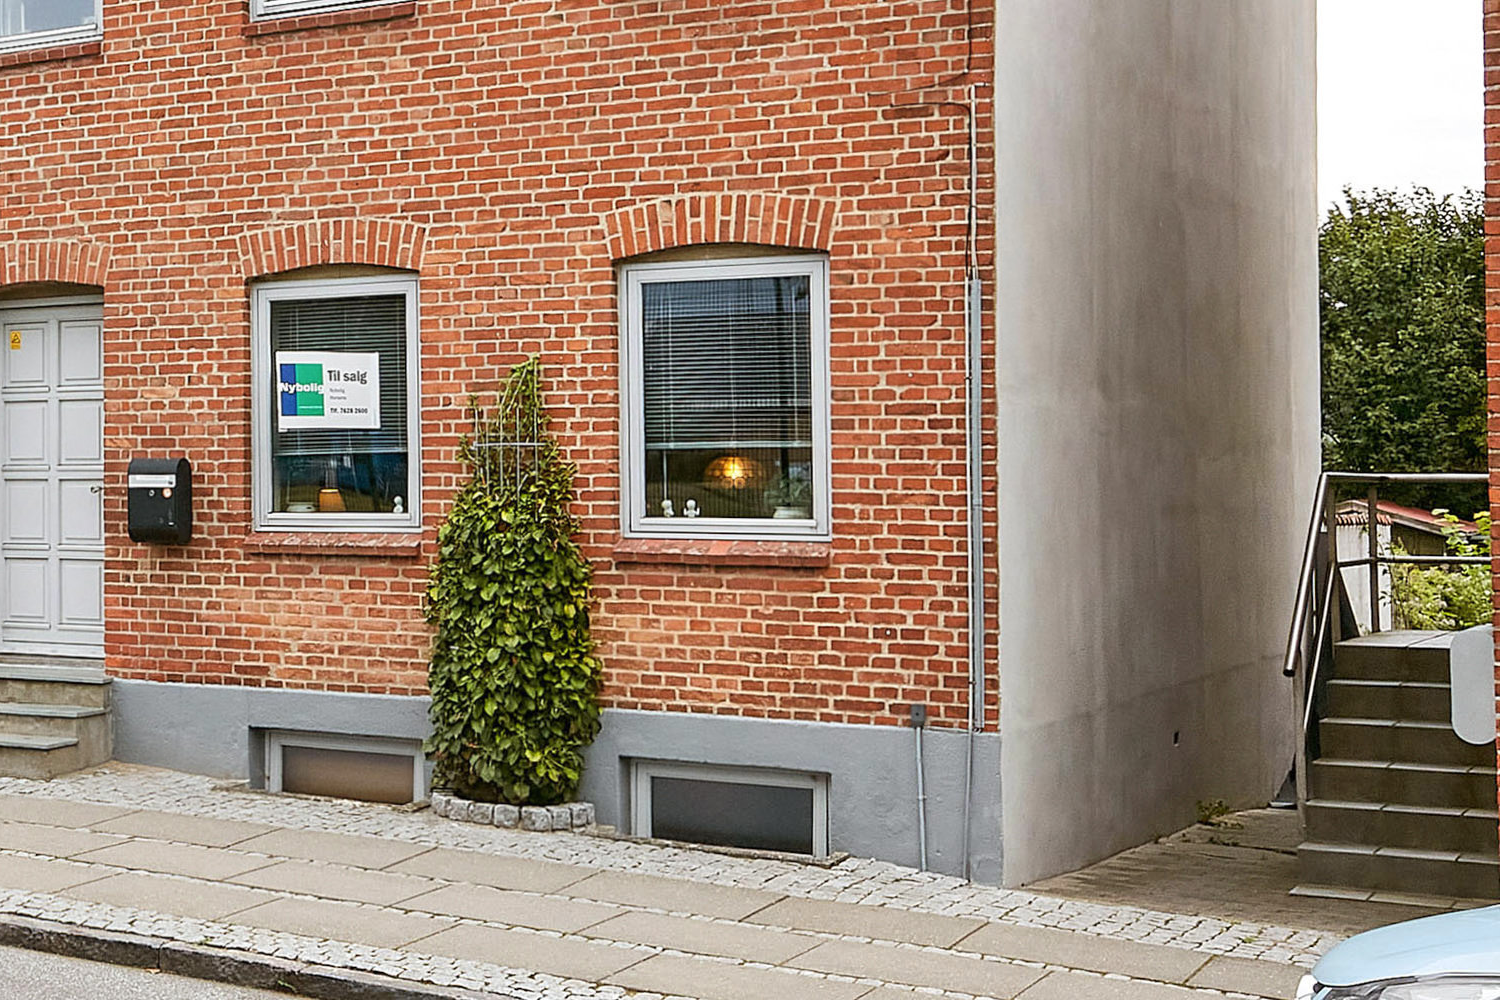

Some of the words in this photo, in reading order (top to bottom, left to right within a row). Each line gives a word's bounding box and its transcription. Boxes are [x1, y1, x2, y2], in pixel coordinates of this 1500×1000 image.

[327, 370, 340, 381] Til
[343, 370, 367, 384] salg
[279, 382, 324, 394] Nybolig
